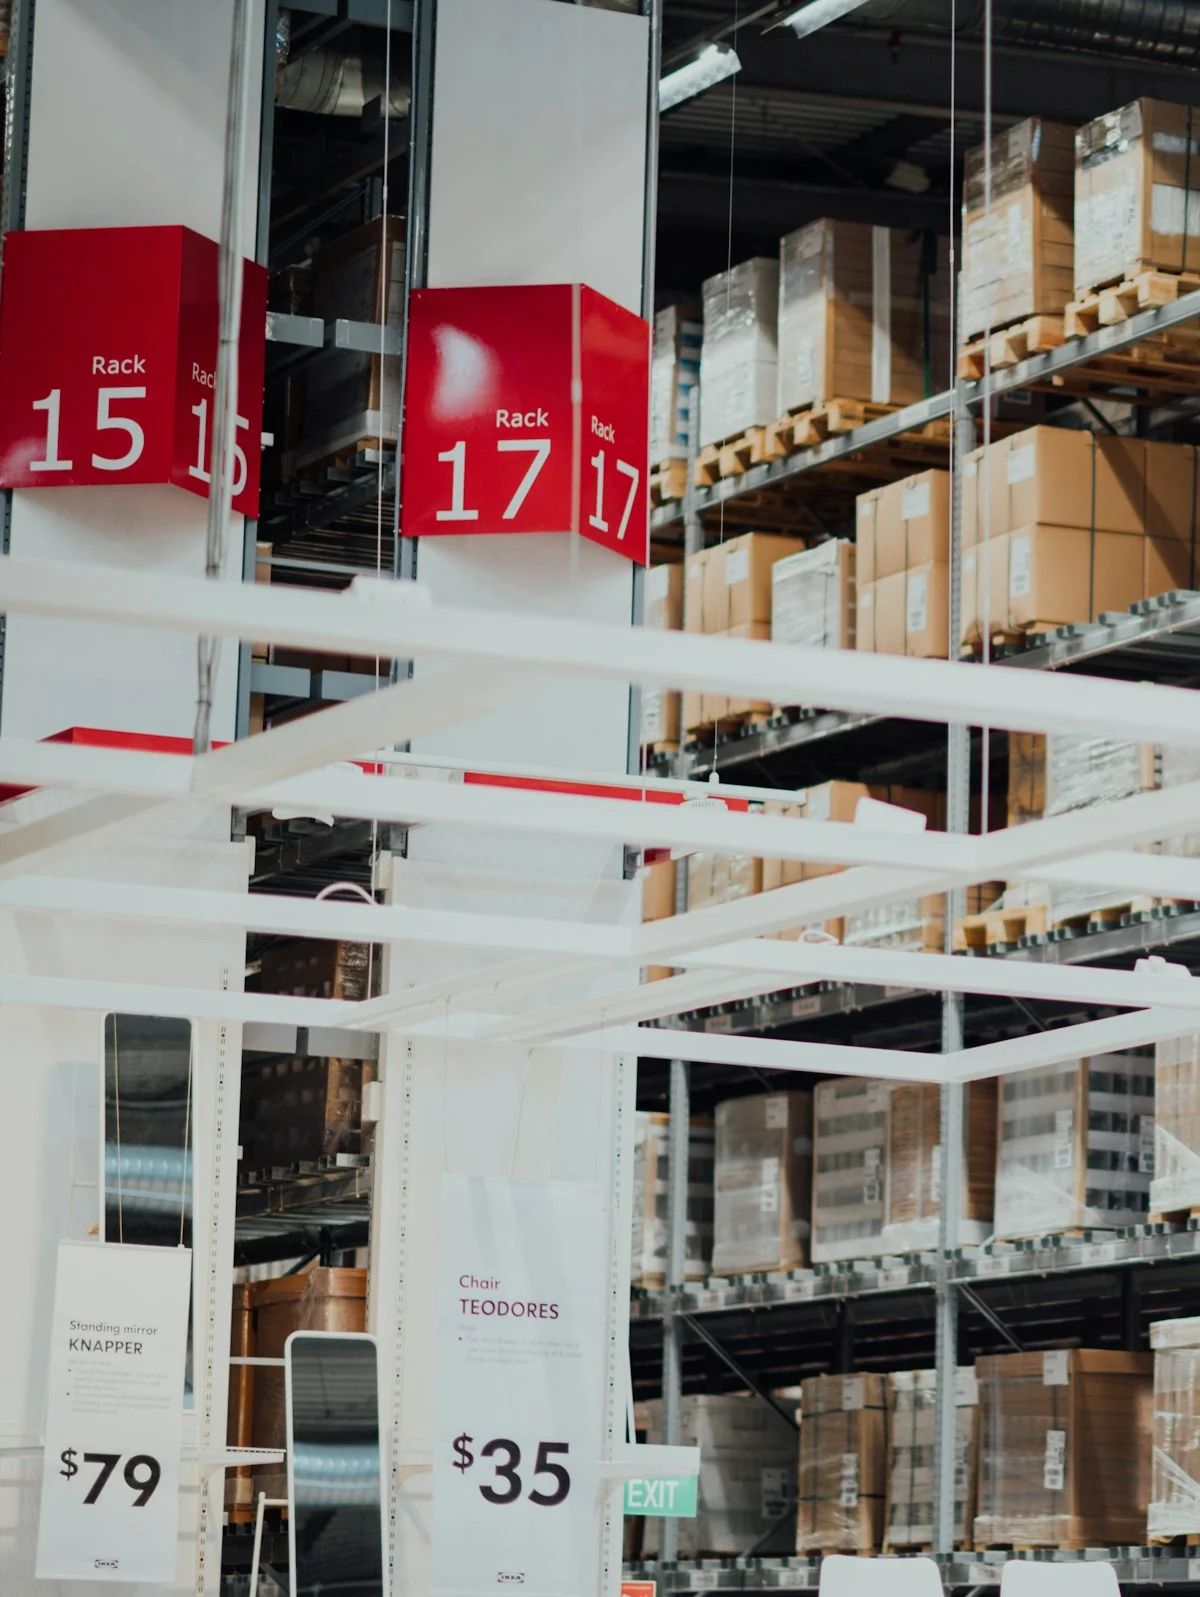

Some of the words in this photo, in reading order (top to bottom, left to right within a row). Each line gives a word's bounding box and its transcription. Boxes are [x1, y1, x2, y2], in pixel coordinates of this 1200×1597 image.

[92, 355, 147, 376] Rack
[192, 361, 218, 390] Rac
[29, 386, 148, 472] 15
[495, 407, 549, 429] Rack
[590, 415, 616, 444] Rack
[436, 438, 551, 521] 17
[588, 448, 640, 541] 17
[459, 1274, 501, 1290] Chair
[459, 1298, 559, 1320] TEODORES
[69, 1320, 120, 1335] Standing
[123, 1324, 158, 1336] mirror
[69, 1338, 143, 1355] KNAPPER
[60, 1447, 162, 1508] $79
[452, 1432, 571, 1507] $35
[628, 1479, 679, 1510] EXIT
